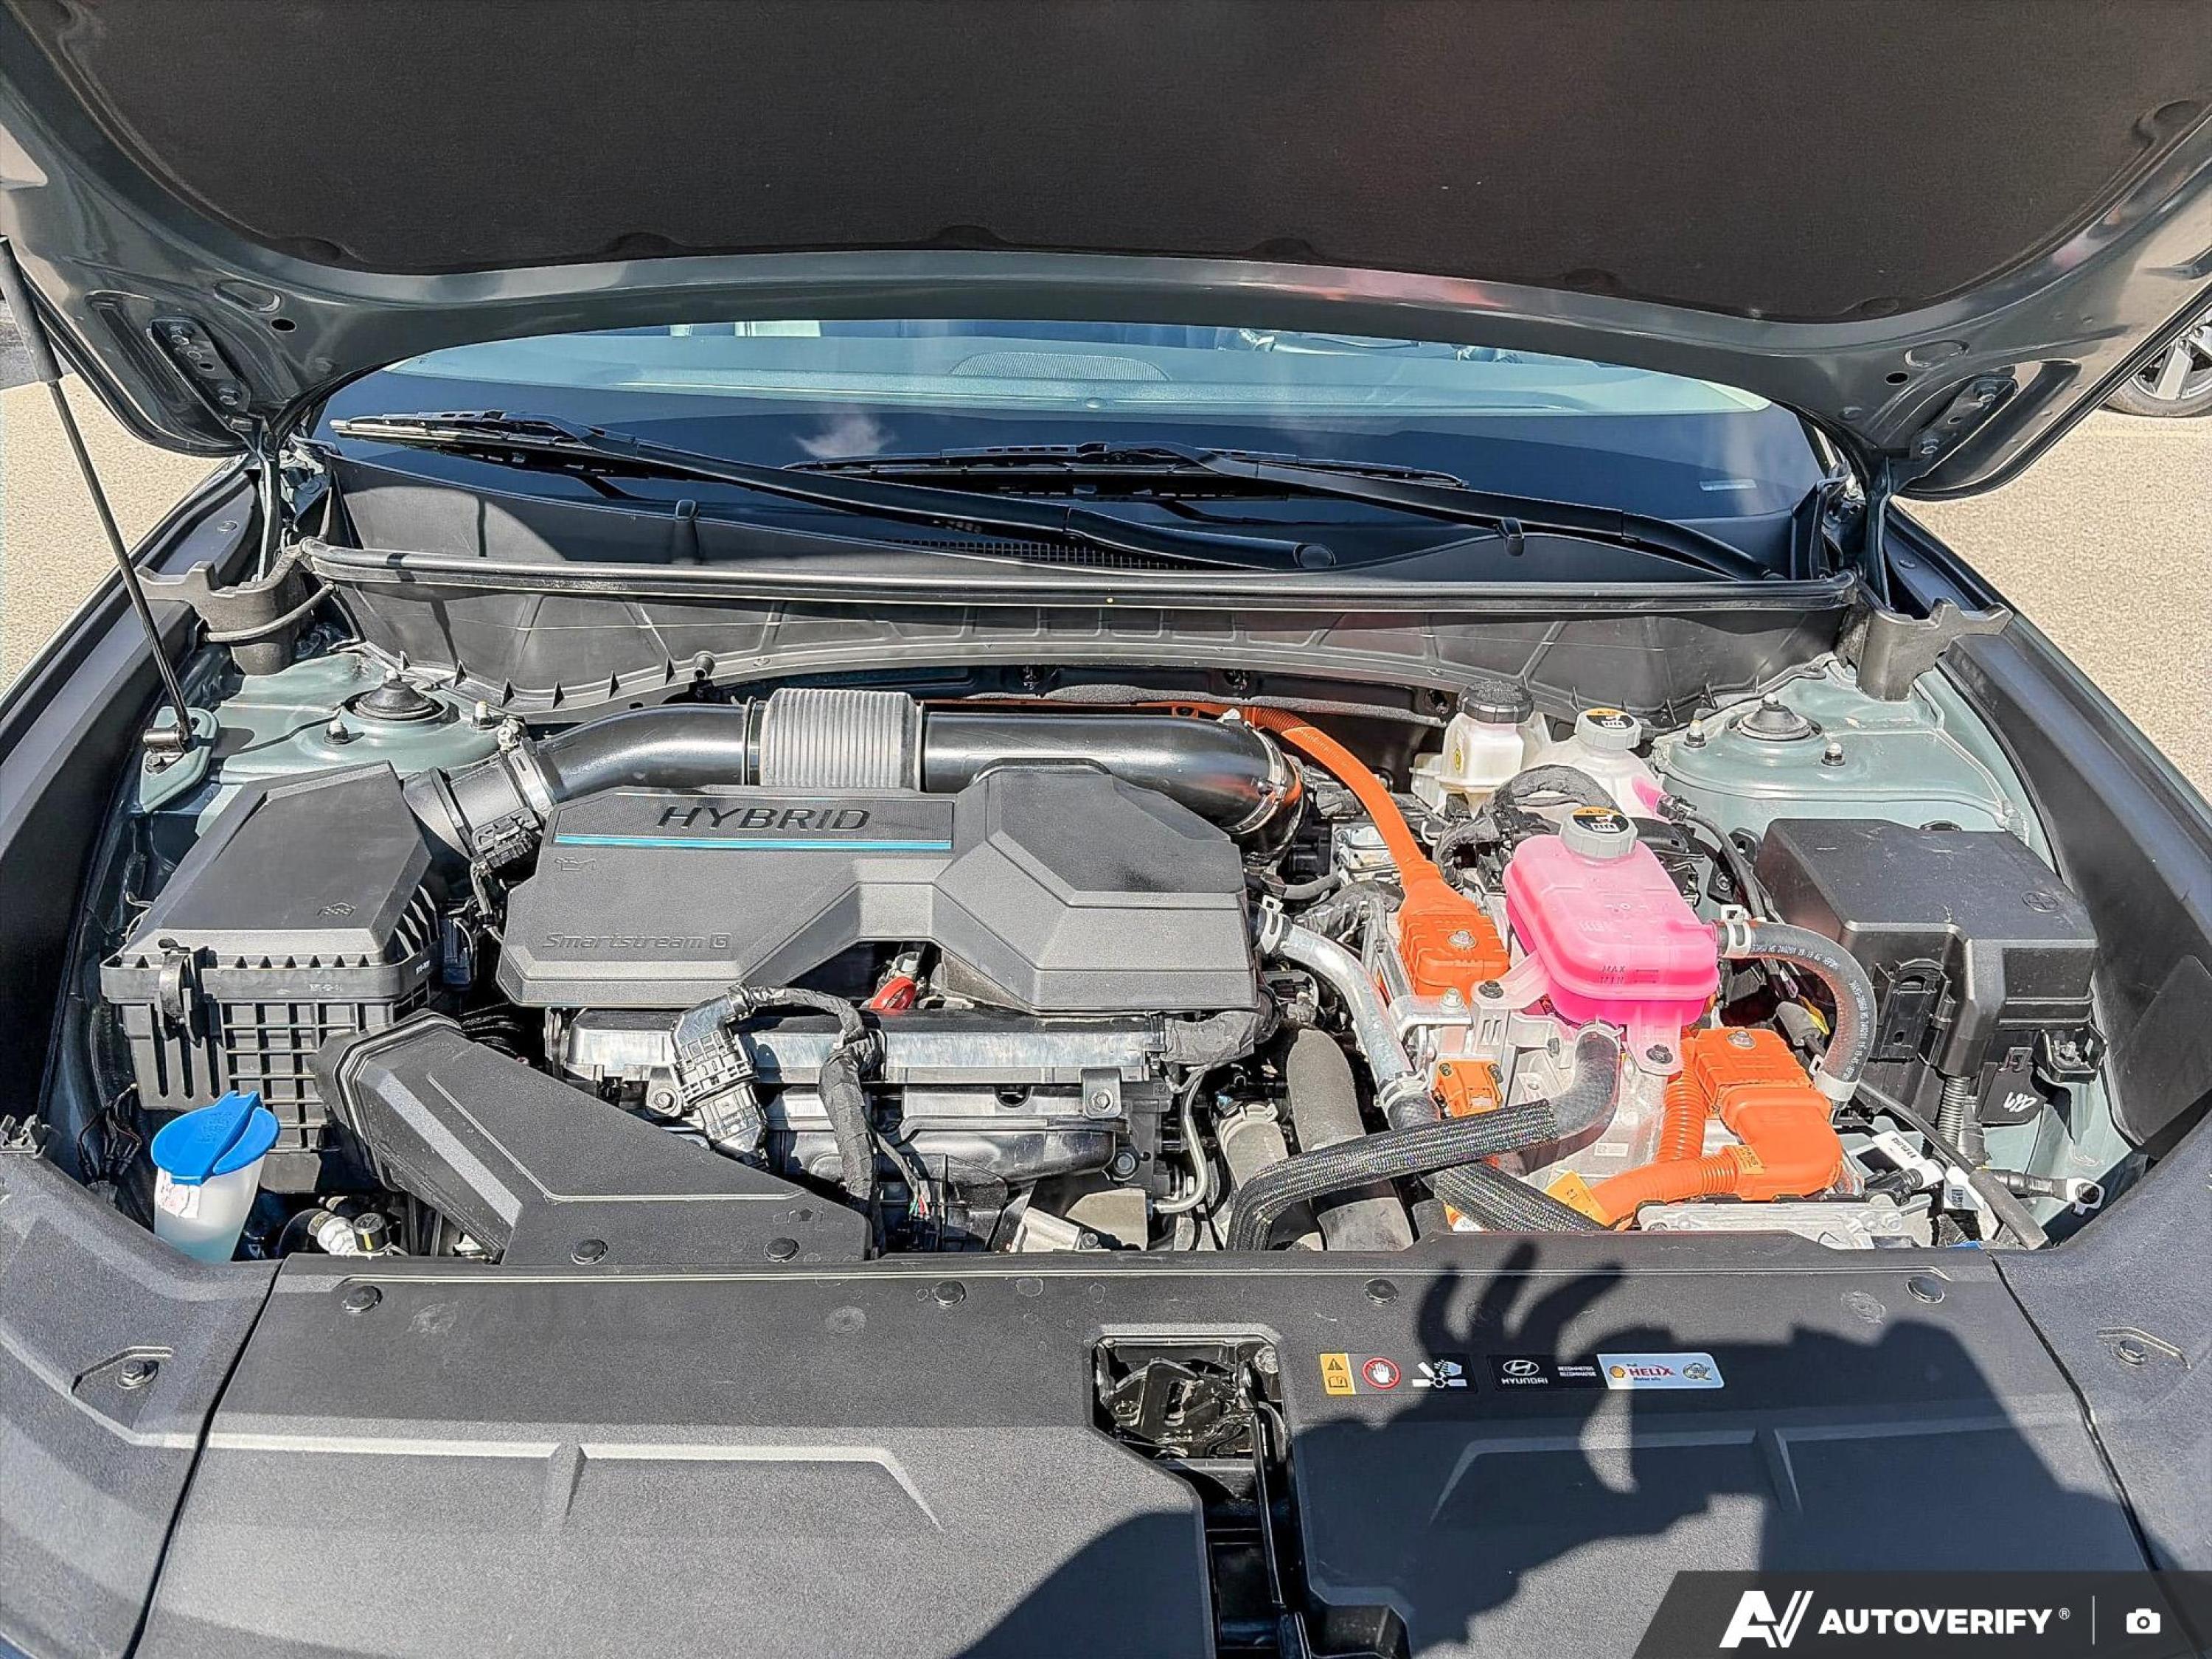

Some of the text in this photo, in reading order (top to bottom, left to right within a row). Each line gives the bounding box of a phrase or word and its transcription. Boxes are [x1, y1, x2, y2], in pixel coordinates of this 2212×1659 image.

[656, 806, 871, 831] HYBRID
[543, 933, 706, 949] Smartstream
[1601, 965, 1625, 973] MAX
[1628, 1367, 1673, 1376] HELIX
[1501, 1377, 1548, 1385] HYUNDAI
